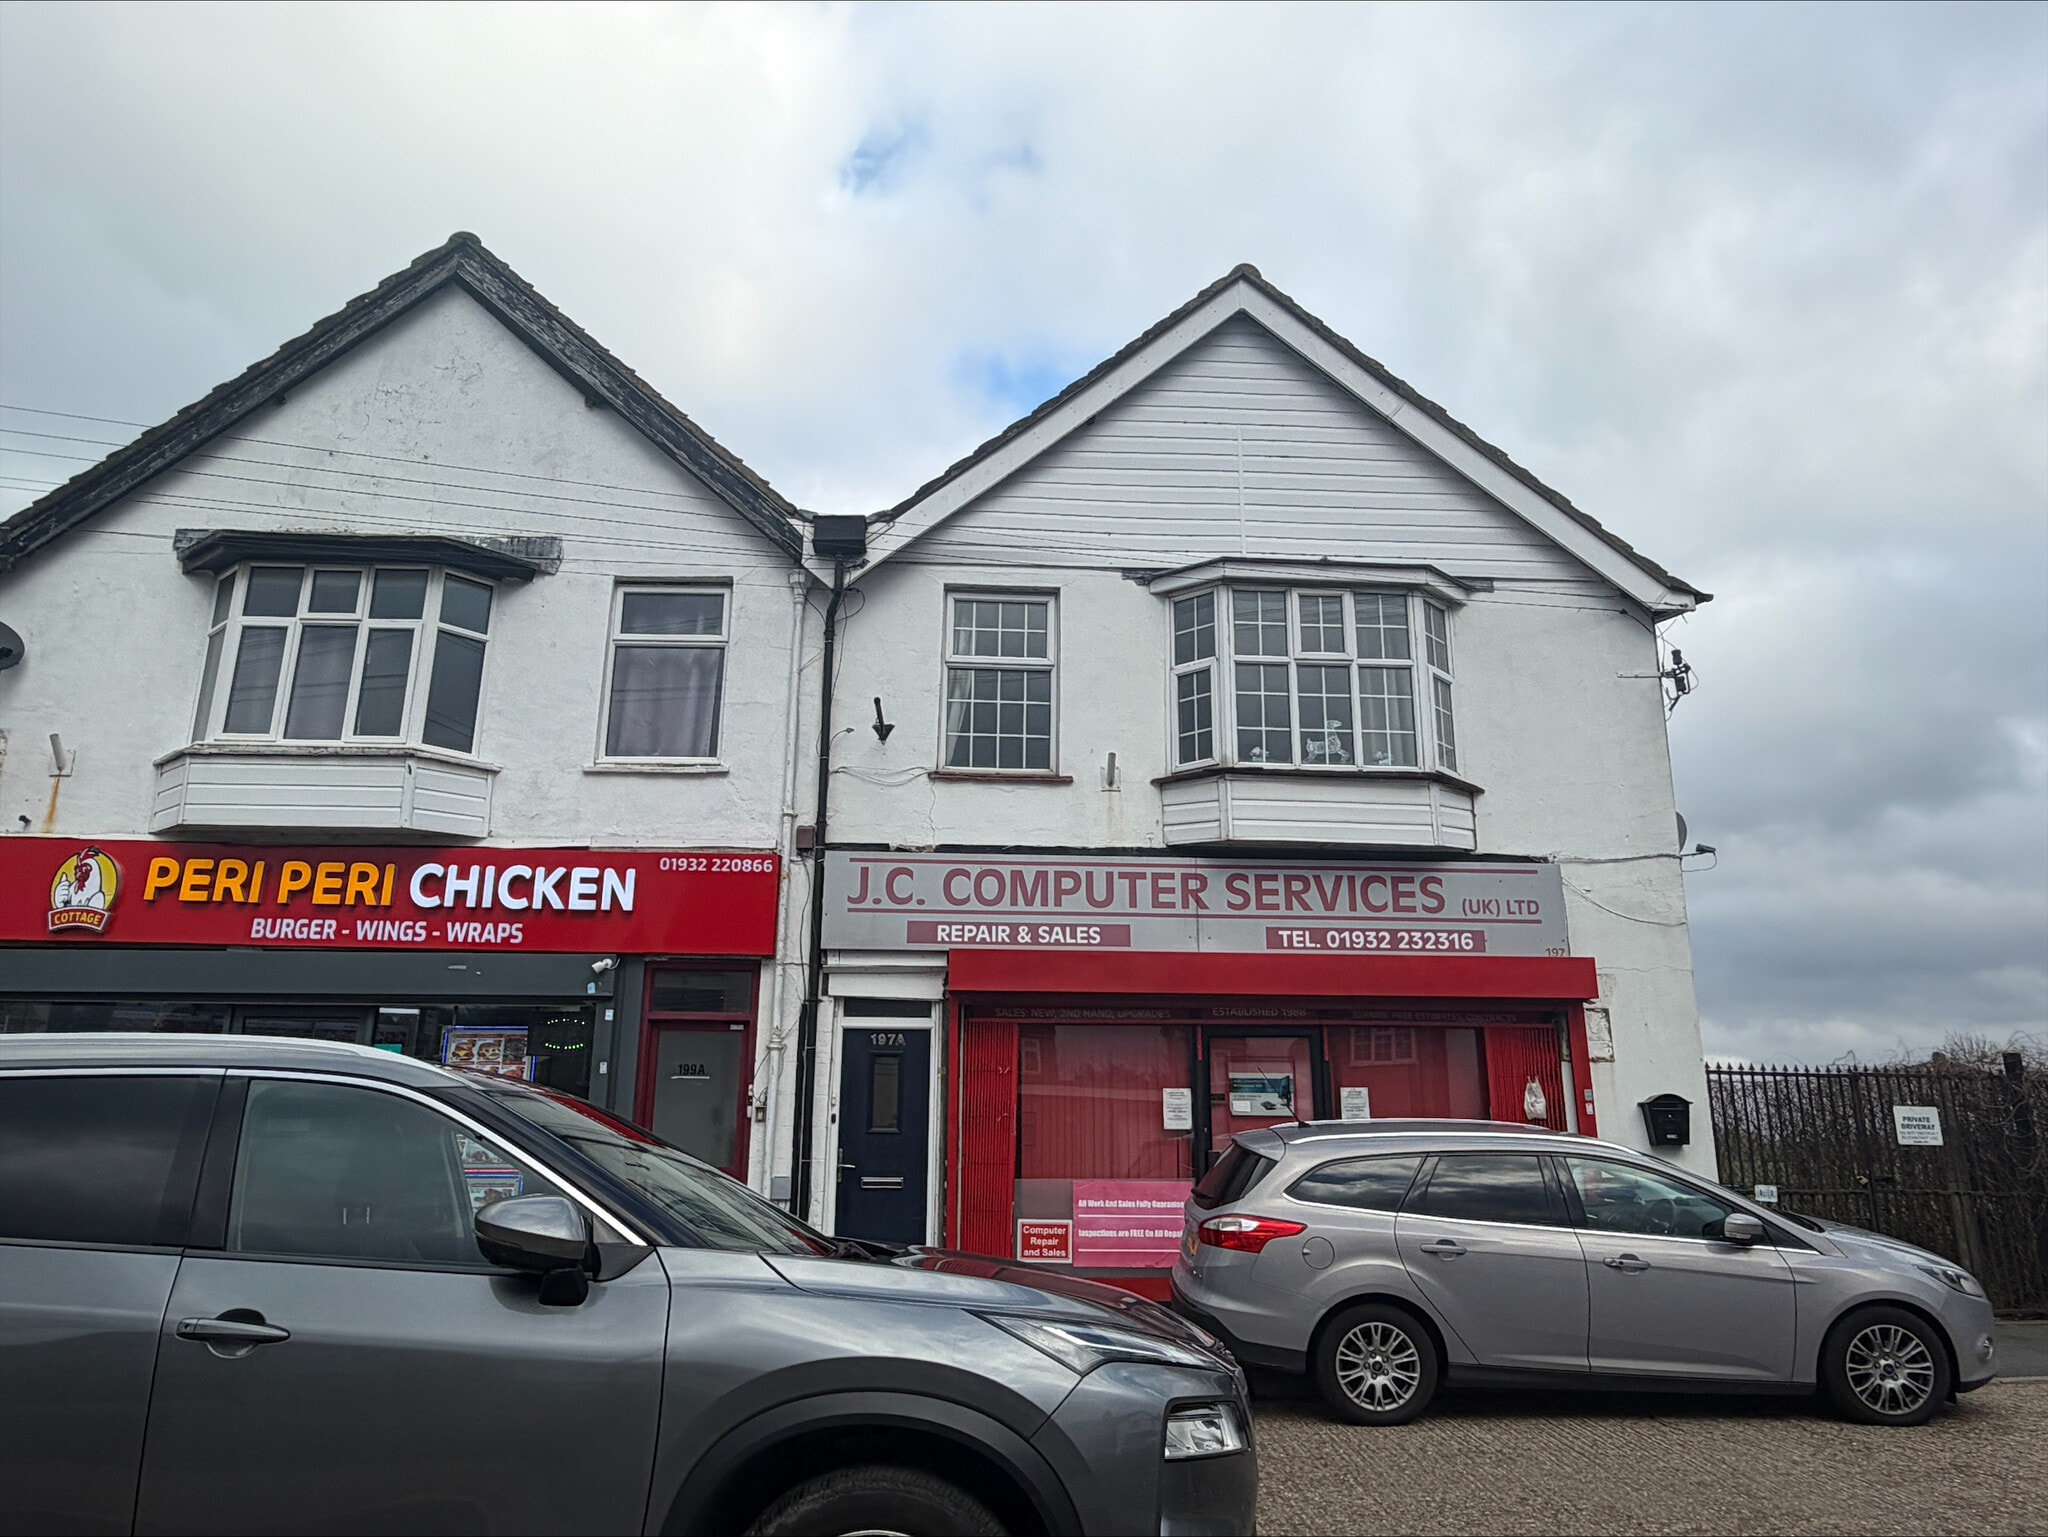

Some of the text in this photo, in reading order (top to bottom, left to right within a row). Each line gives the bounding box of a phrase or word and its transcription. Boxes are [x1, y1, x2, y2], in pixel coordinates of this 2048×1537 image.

[659, 857, 773, 873] 01932 220866
[143, 857, 636, 912] PERI PERI CHICKEN
[847, 866, 1540, 918] J.C. COMPUTER SERVICES (UK) LTD
[54, 911, 101, 926] COTTAGE
[250, 917, 337, 940] BURGER
[356, 920, 427, 942] WINGS
[446, 921, 523, 944] WRAPS
[936, 924, 1101, 945] REPAIR & SALES
[1278, 930, 1473, 950] TEL. 01932 232316
[1545, 947, 1565, 957] 197
[1117, 1008, 1171, 1018] UPGRADES
[1212, 1007, 1279, 1017] ESTABLISHED
[870, 1033, 906, 1046] 197A
[677, 1064, 706, 1076] 199A
[1117, 1199, 1136, 1208] Sales
[1023, 1225, 1067, 1236] Computer
[1078, 1229, 1117, 1238] Inspections
[1130, 1229, 1145, 1238] FREE
[1030, 1236, 1060, 1247] Repair
[1023, 1248, 1067, 1257] and Sales
